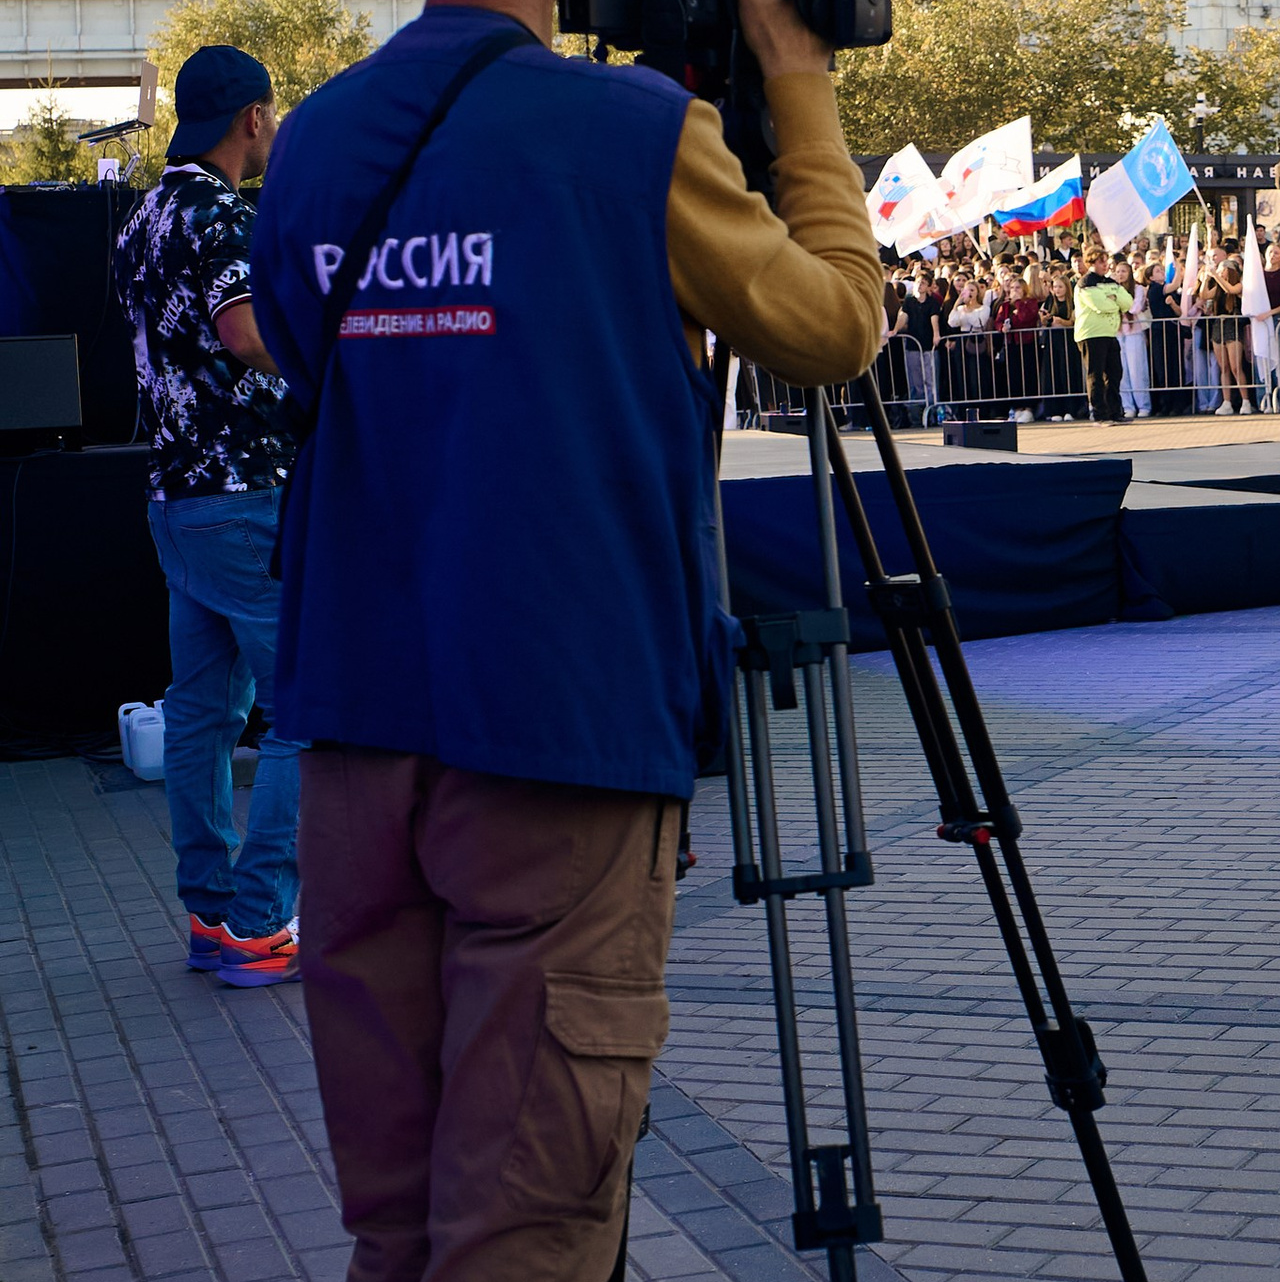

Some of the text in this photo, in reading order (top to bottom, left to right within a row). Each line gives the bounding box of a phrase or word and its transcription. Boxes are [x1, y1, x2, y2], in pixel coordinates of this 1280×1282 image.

[157, 281, 196, 337] Kappa
[425, 314, 436, 331] И
[436, 310, 492, 332] РАДИО
